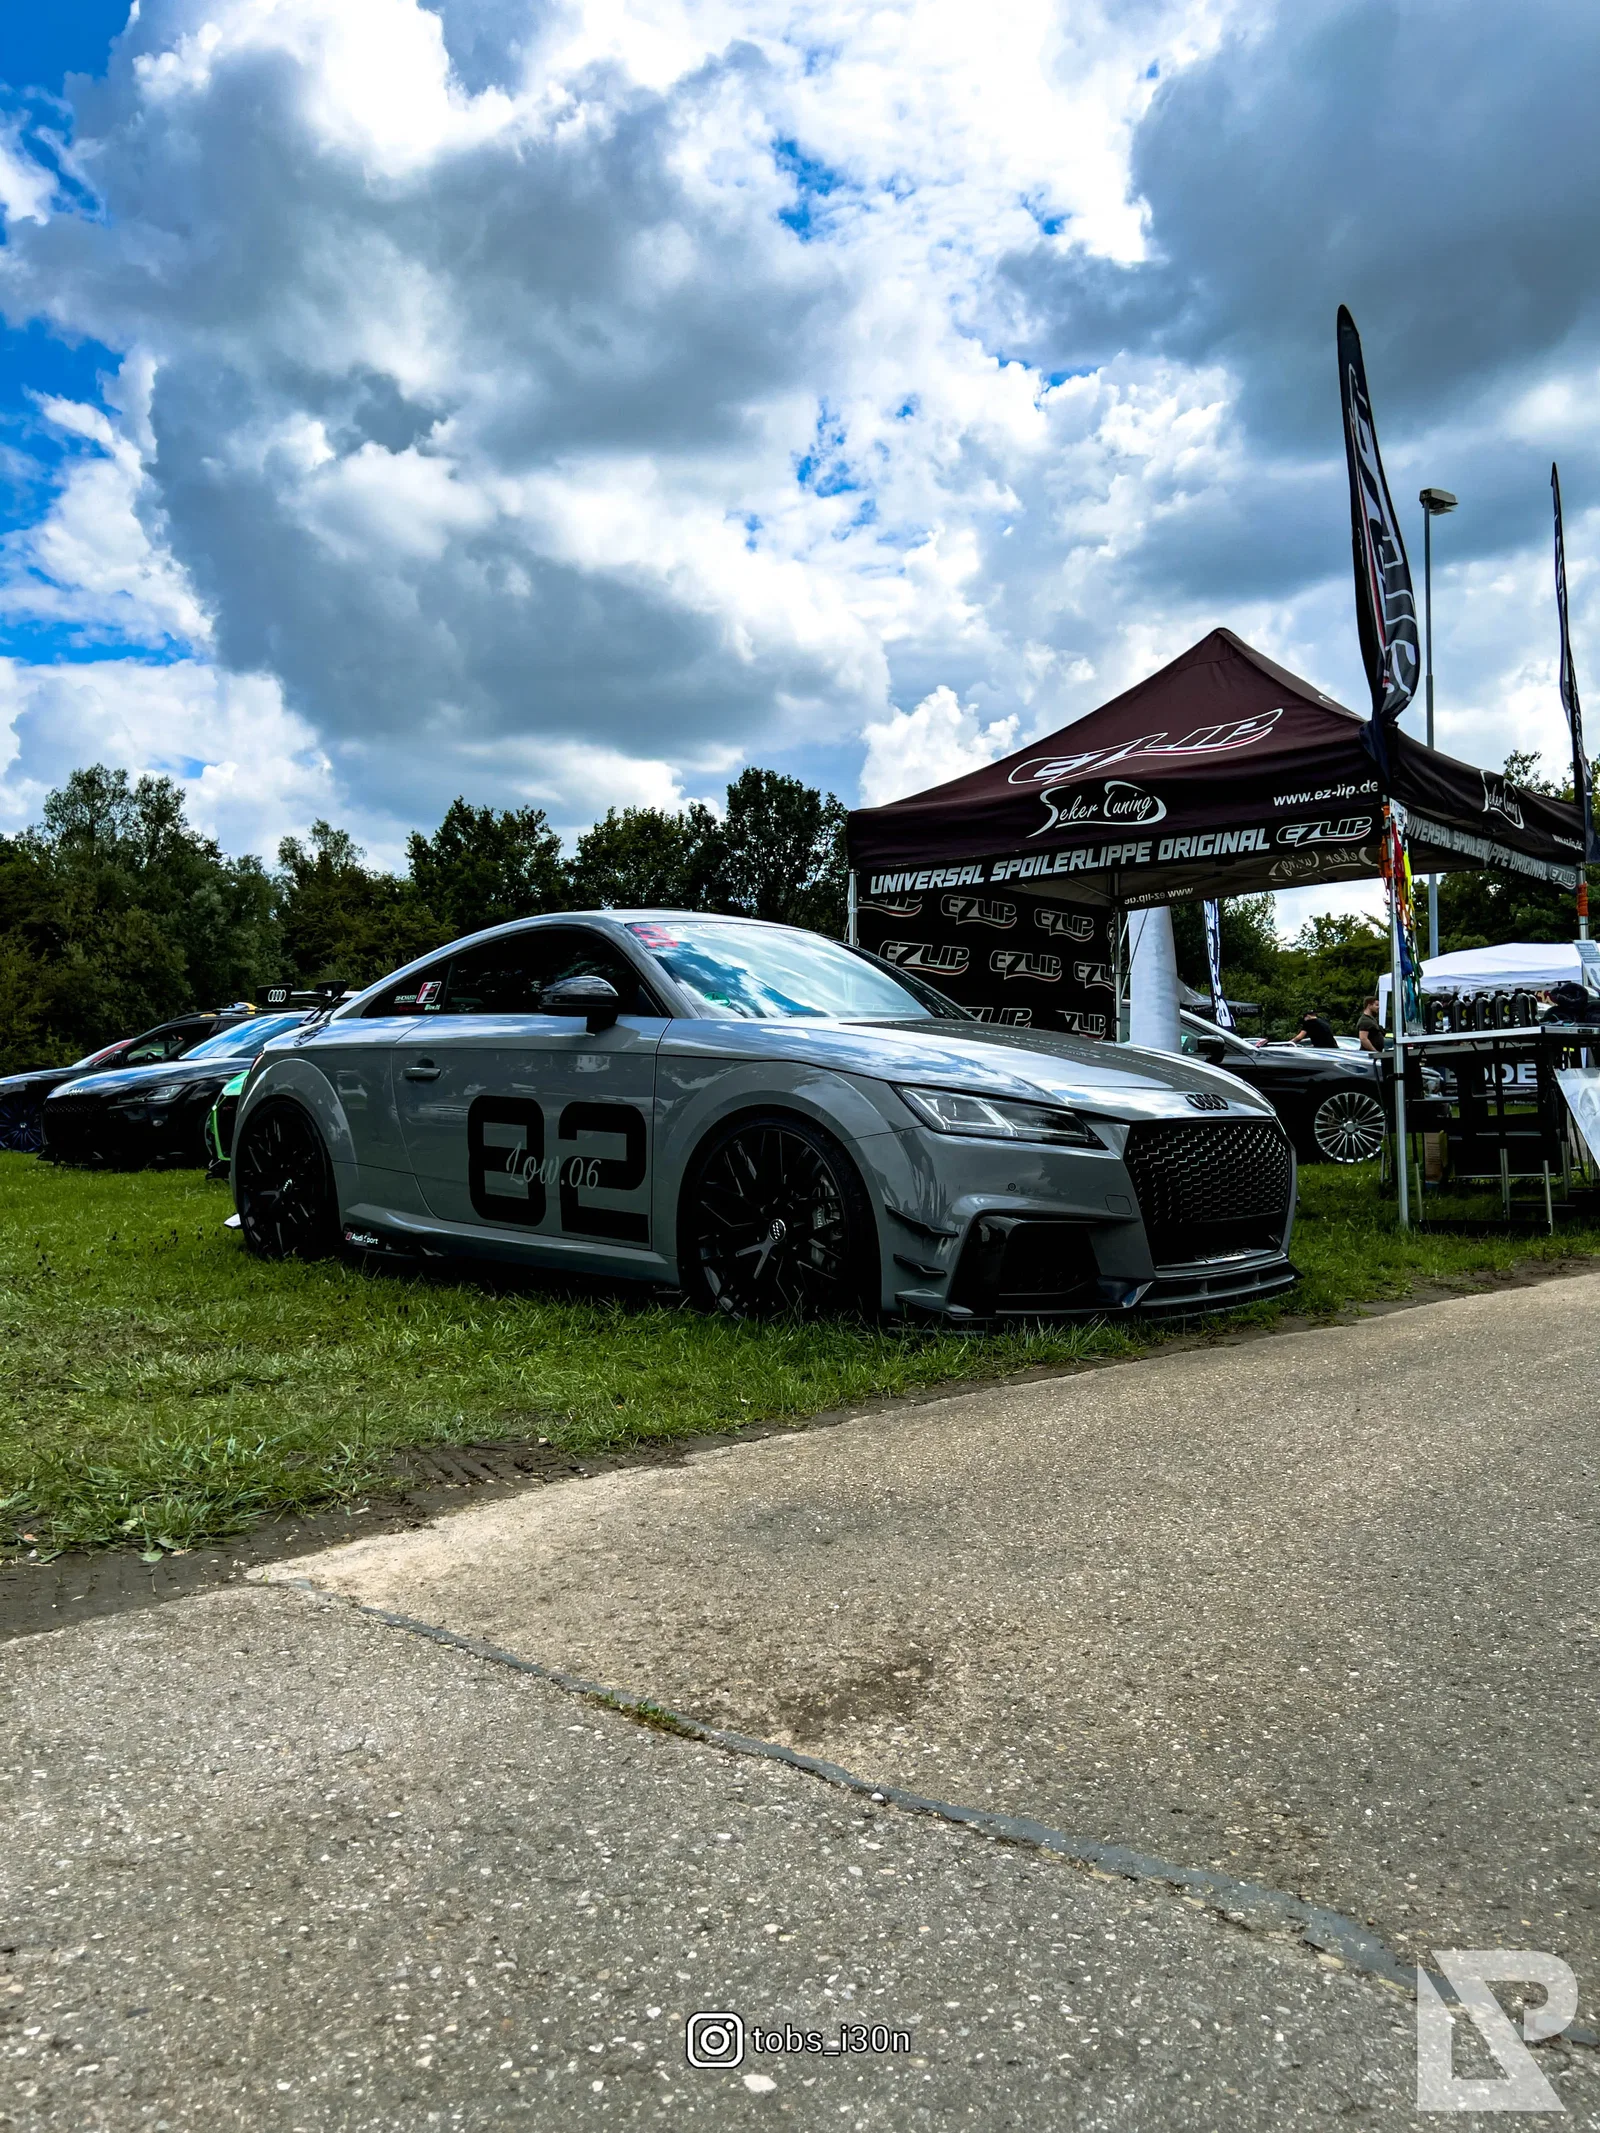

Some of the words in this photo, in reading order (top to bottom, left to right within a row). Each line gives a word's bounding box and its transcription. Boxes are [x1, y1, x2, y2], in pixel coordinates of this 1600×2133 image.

[1026, 785, 1098, 838] Seker
[1104, 781, 1154, 822] Tuning
[1273, 779, 1379, 806] www.ez-lip.de
[870, 864, 985, 894] UNIVERSAL
[990, 841, 1153, 881] SPOILERLIPPE
[1158, 828, 1270, 861] ORIGINAL
[1509, 851, 1548, 880] ORIGINAL
[467, 1094, 651, 1244] 82
[505, 1141, 602, 1190] Low.06
